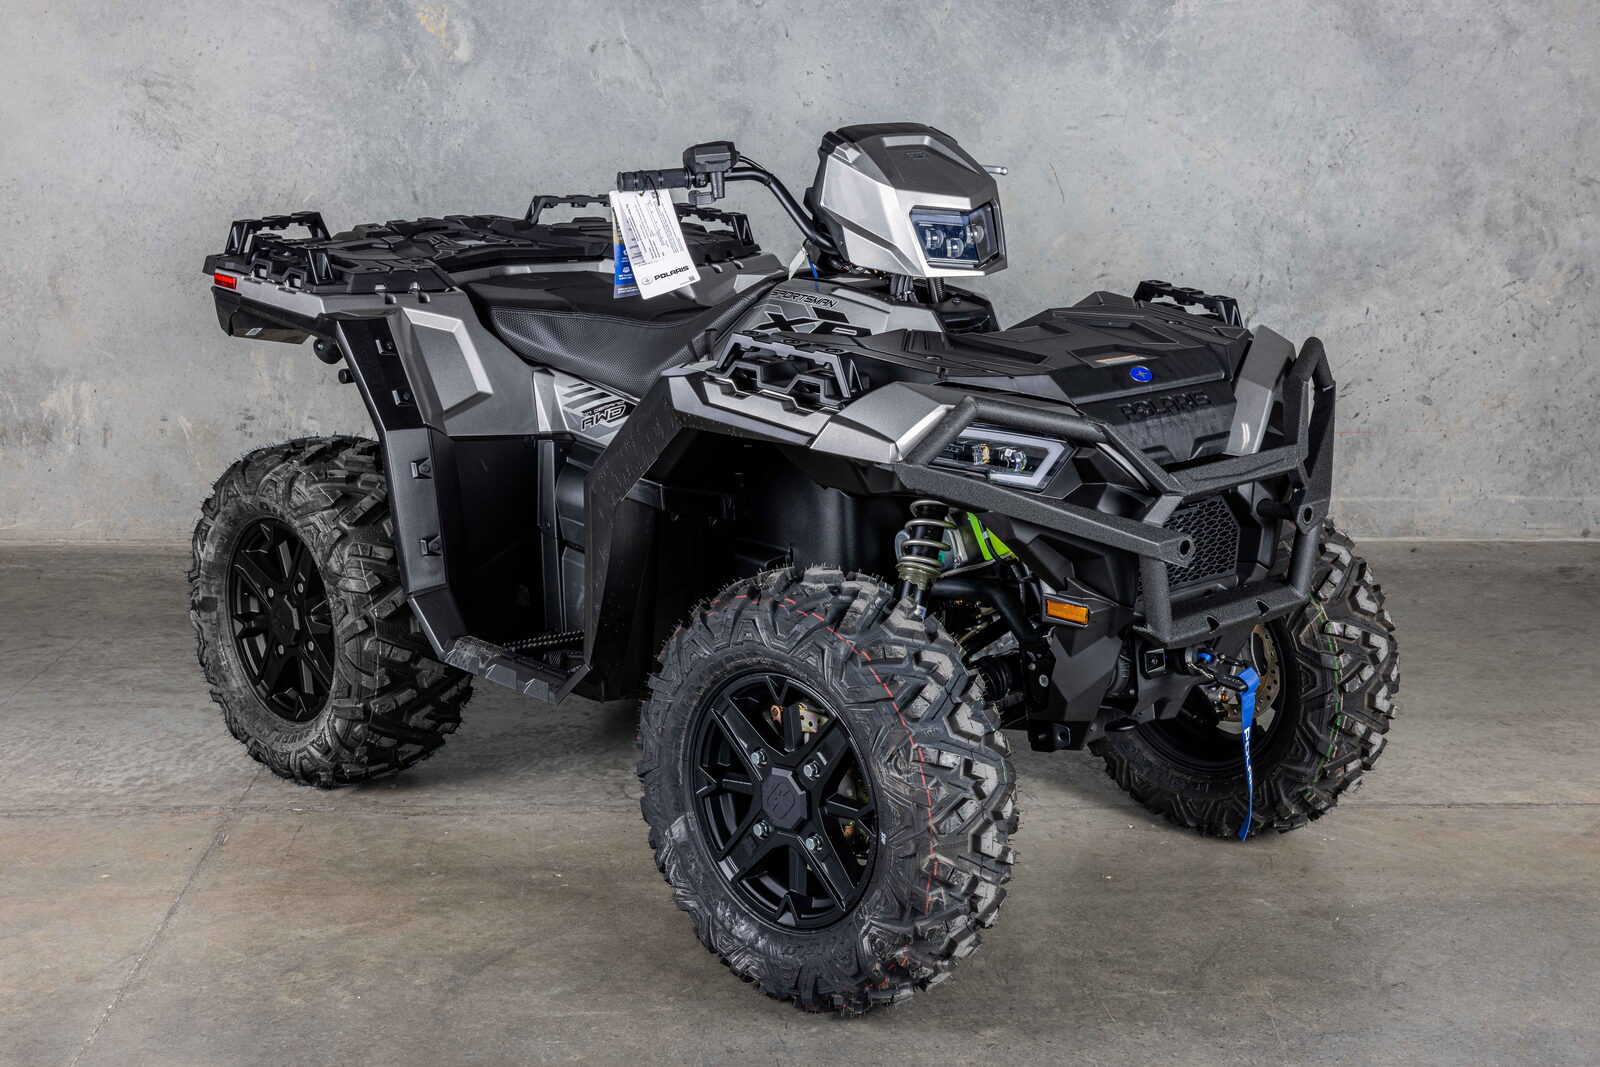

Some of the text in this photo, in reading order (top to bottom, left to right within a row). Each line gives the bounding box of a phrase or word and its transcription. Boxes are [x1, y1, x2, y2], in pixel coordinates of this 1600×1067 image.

[653, 265, 689, 280] POLARIS
[770, 289, 838, 308] SPORTSMAN
[1116, 390, 1212, 419] POLARIS
[581, 405, 626, 431] AWD
